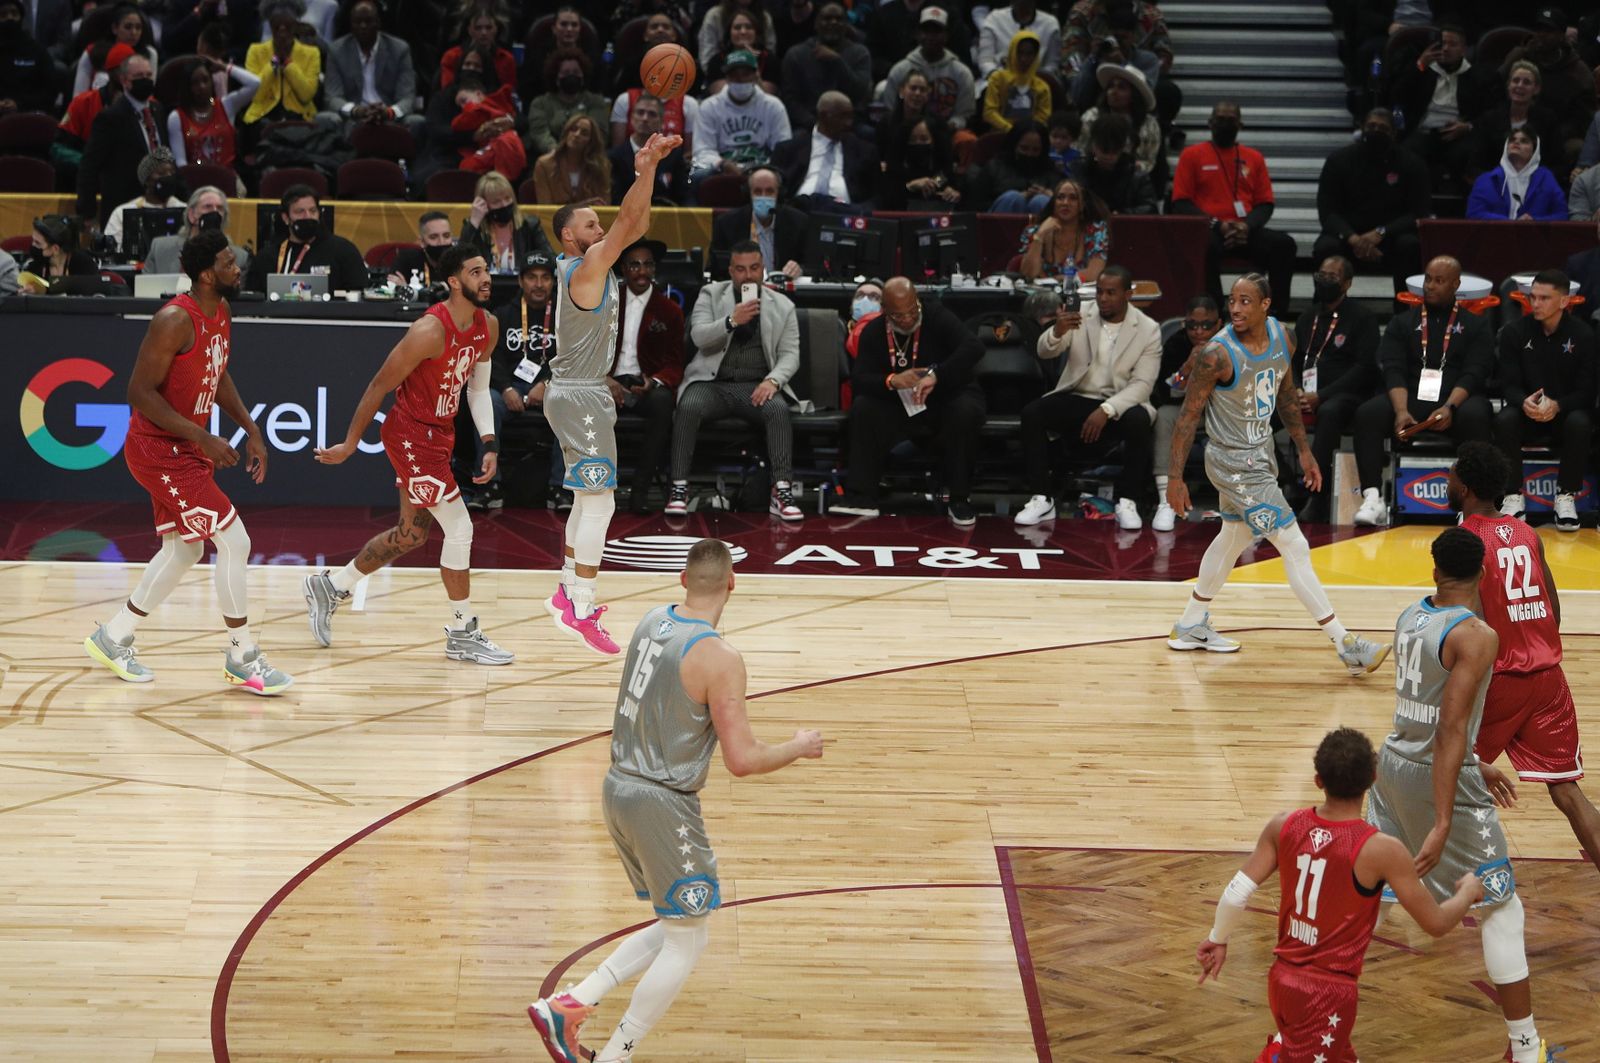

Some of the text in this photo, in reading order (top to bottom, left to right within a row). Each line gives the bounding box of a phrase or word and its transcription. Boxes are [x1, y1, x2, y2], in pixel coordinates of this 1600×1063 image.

[1413, 482, 1449, 499] CLOR
[774, 545, 1064, 569] AT&T
[1497, 545, 1540, 600] 22
[627, 637, 664, 700] 15
[1395, 632, 1423, 696] 34
[1295, 853, 1327, 921] 11
